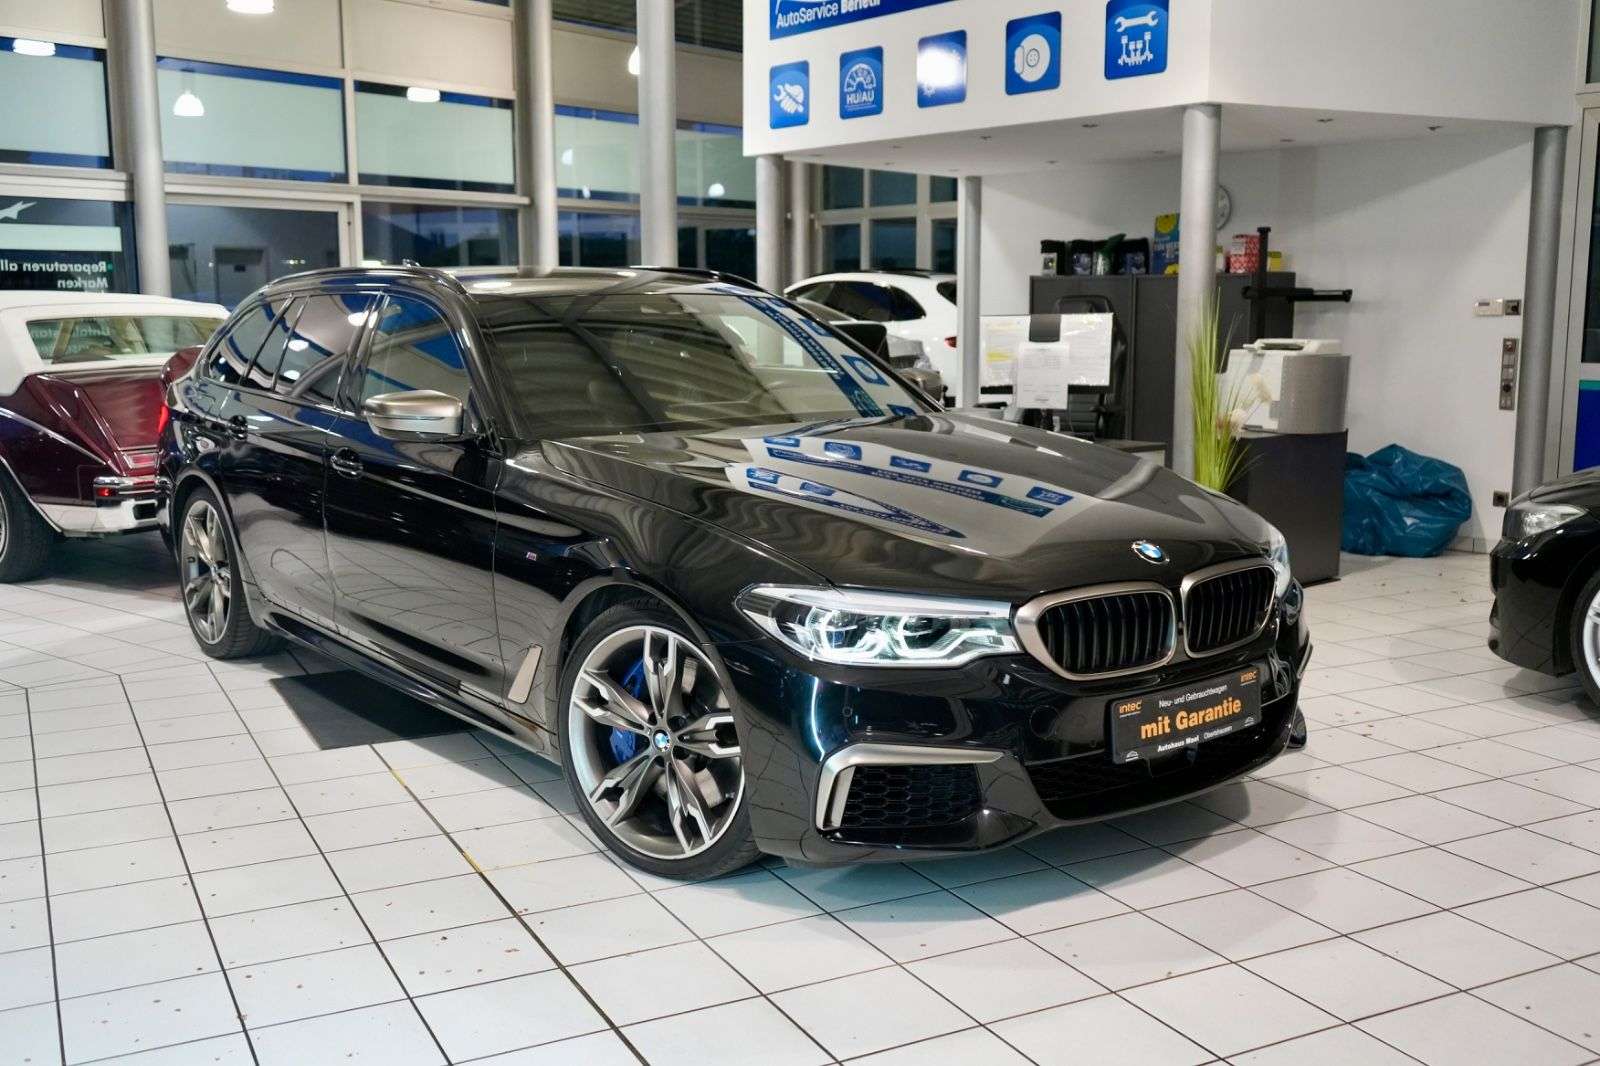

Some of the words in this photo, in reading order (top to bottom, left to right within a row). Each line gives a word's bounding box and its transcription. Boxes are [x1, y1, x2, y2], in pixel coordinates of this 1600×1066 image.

[776, 2, 838, 28] AutoService
[1119, 700, 1142, 714] intec
[1141, 716, 1171, 739] mit
[1176, 697, 1241, 730] Garantie
